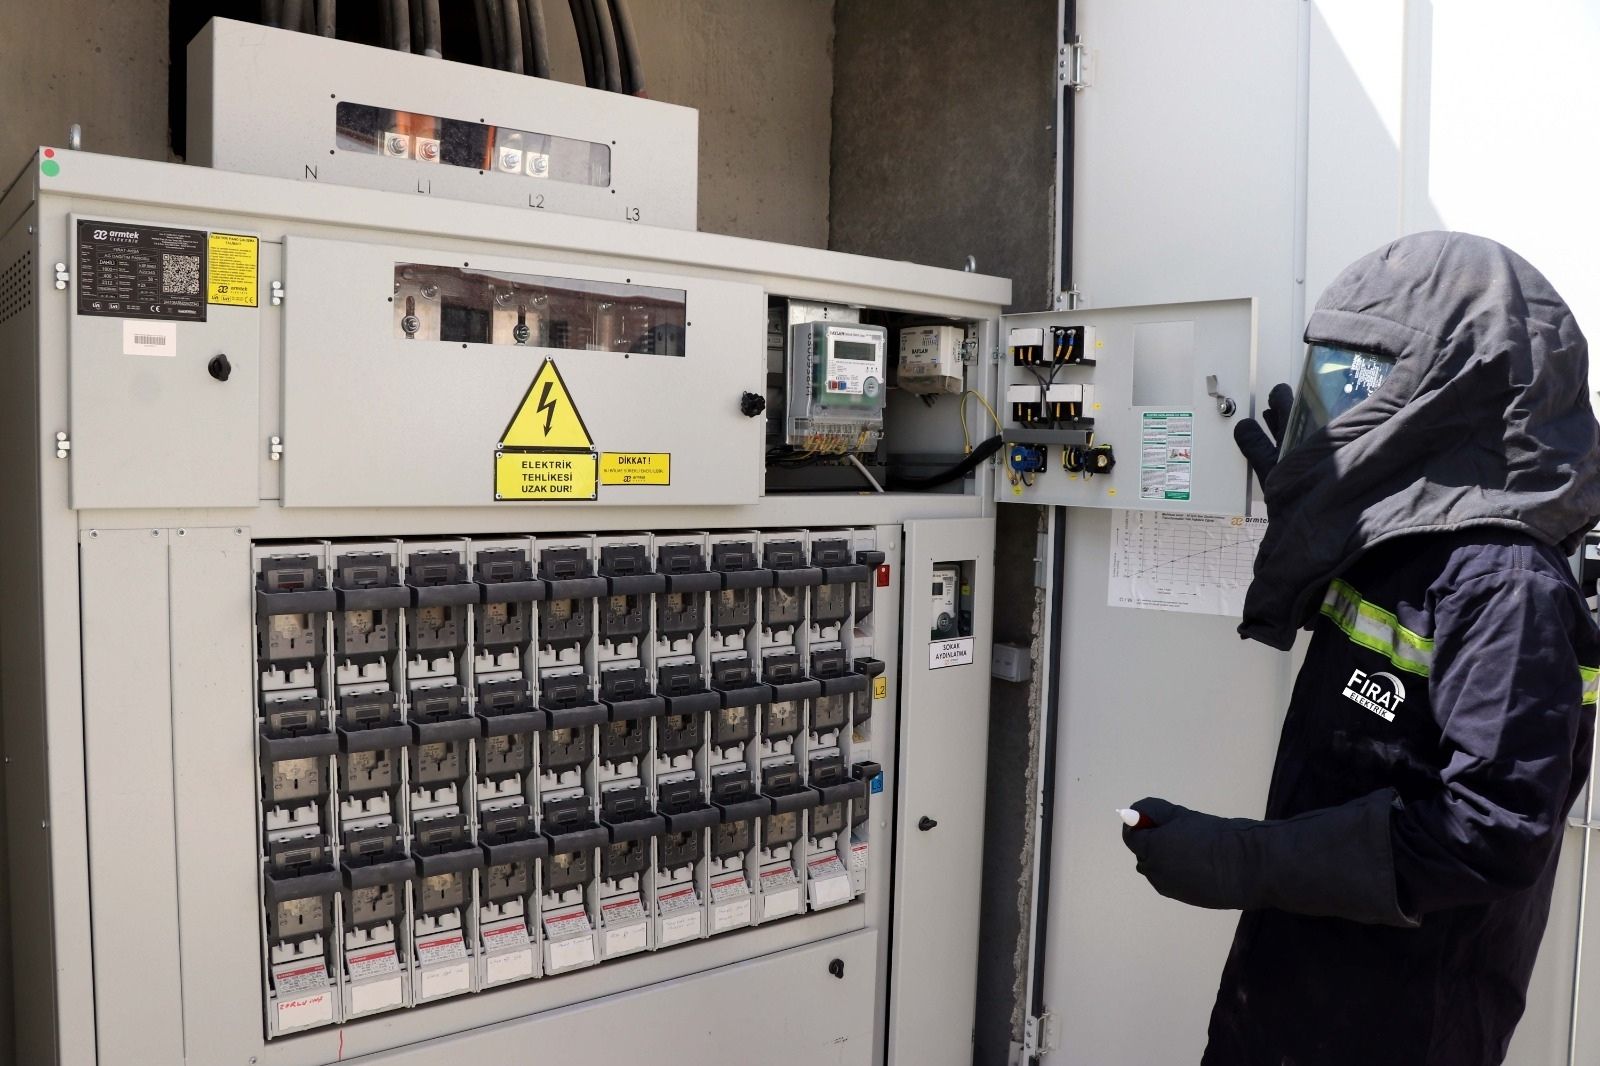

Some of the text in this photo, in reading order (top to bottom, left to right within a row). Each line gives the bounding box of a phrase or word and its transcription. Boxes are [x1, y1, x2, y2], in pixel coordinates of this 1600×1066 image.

[305, 164, 318, 180] N
[417, 179, 431, 194] L1
[528, 193, 545, 209] L2
[625, 207, 641, 222] L3
[109, 230, 140, 239] armtek
[521, 459, 572, 469] ELEKTRİK
[618, 455, 647, 465] DİKKAT
[521, 471, 573, 482] TEHLİKESİ
[521, 484, 573, 493] UZAK DUR!
[943, 642, 961, 651] SOKAK
[935, 649, 967, 660] AYDINLATMA
[875, 685, 885, 696] L2
[1346, 668, 1405, 712] FIRAT
